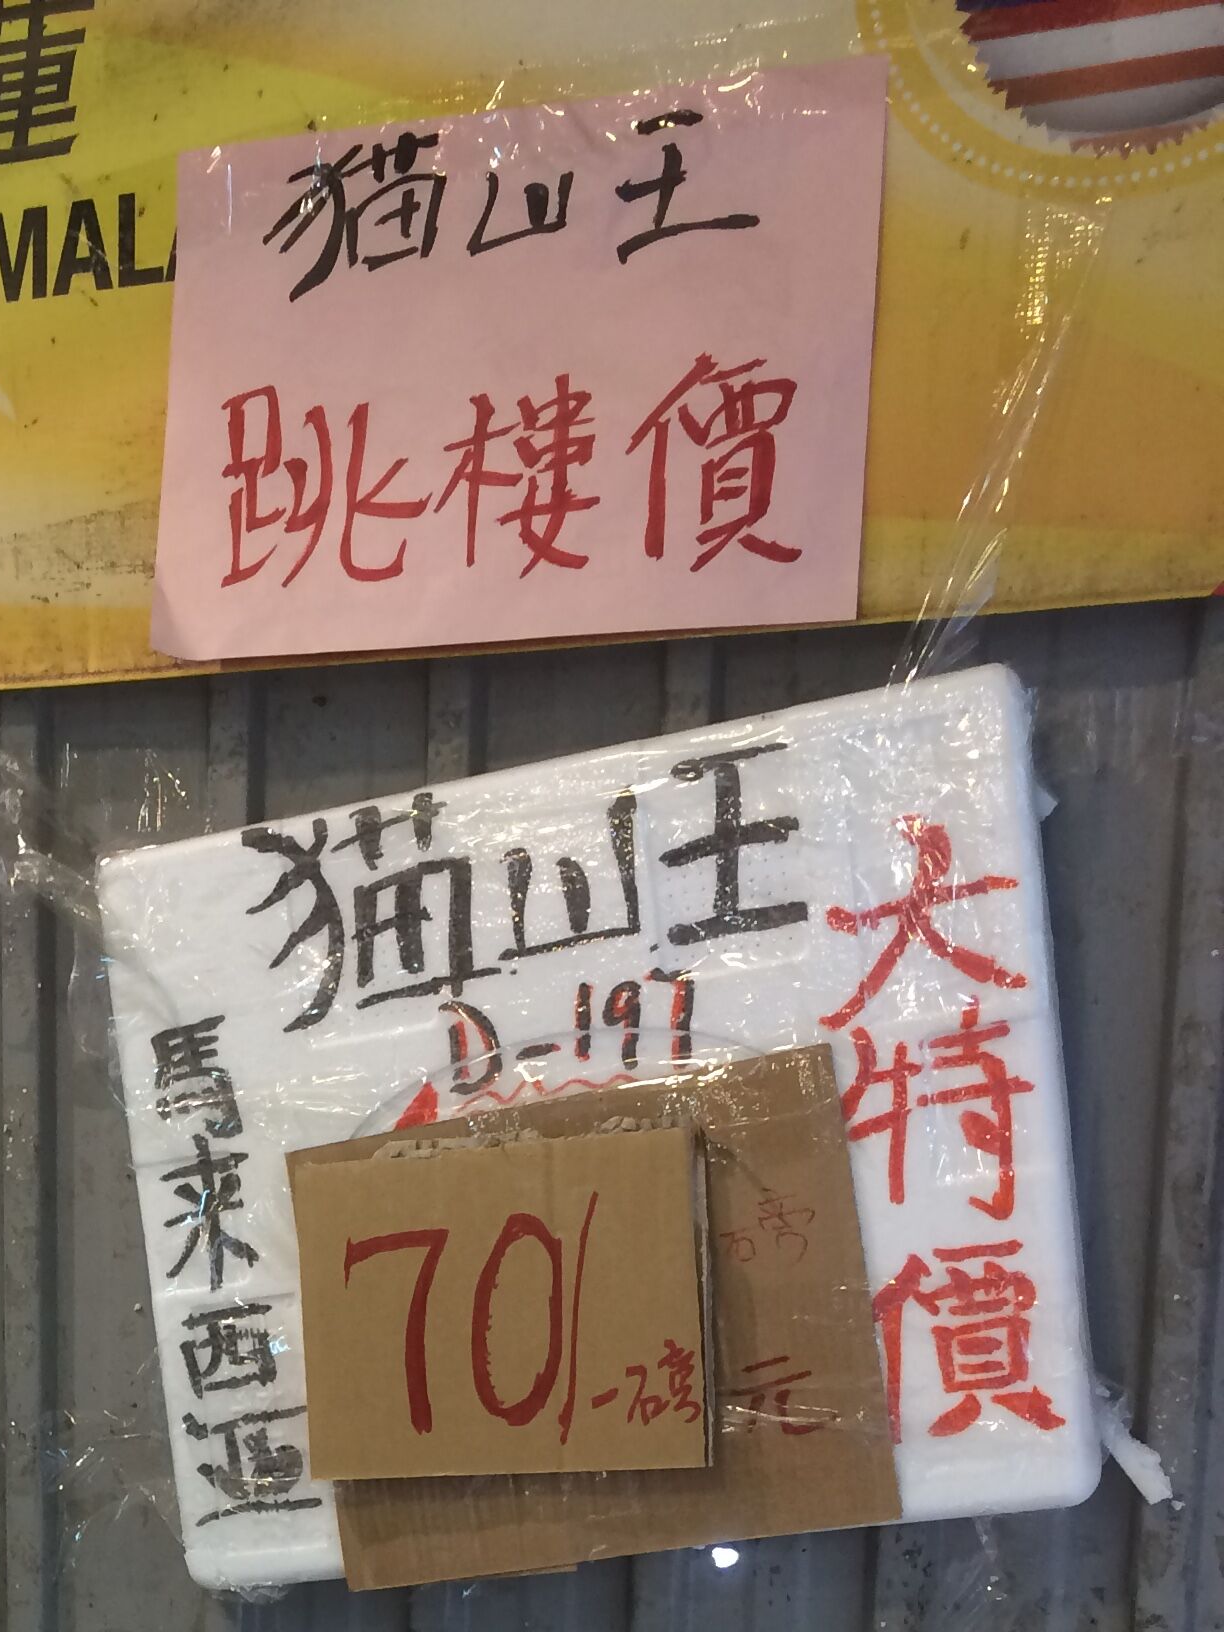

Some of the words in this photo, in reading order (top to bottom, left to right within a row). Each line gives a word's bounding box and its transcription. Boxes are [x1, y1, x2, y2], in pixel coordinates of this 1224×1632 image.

[438, 967, 695, 1096] D-197
[820, 812, 1067, 1445] 大特價
